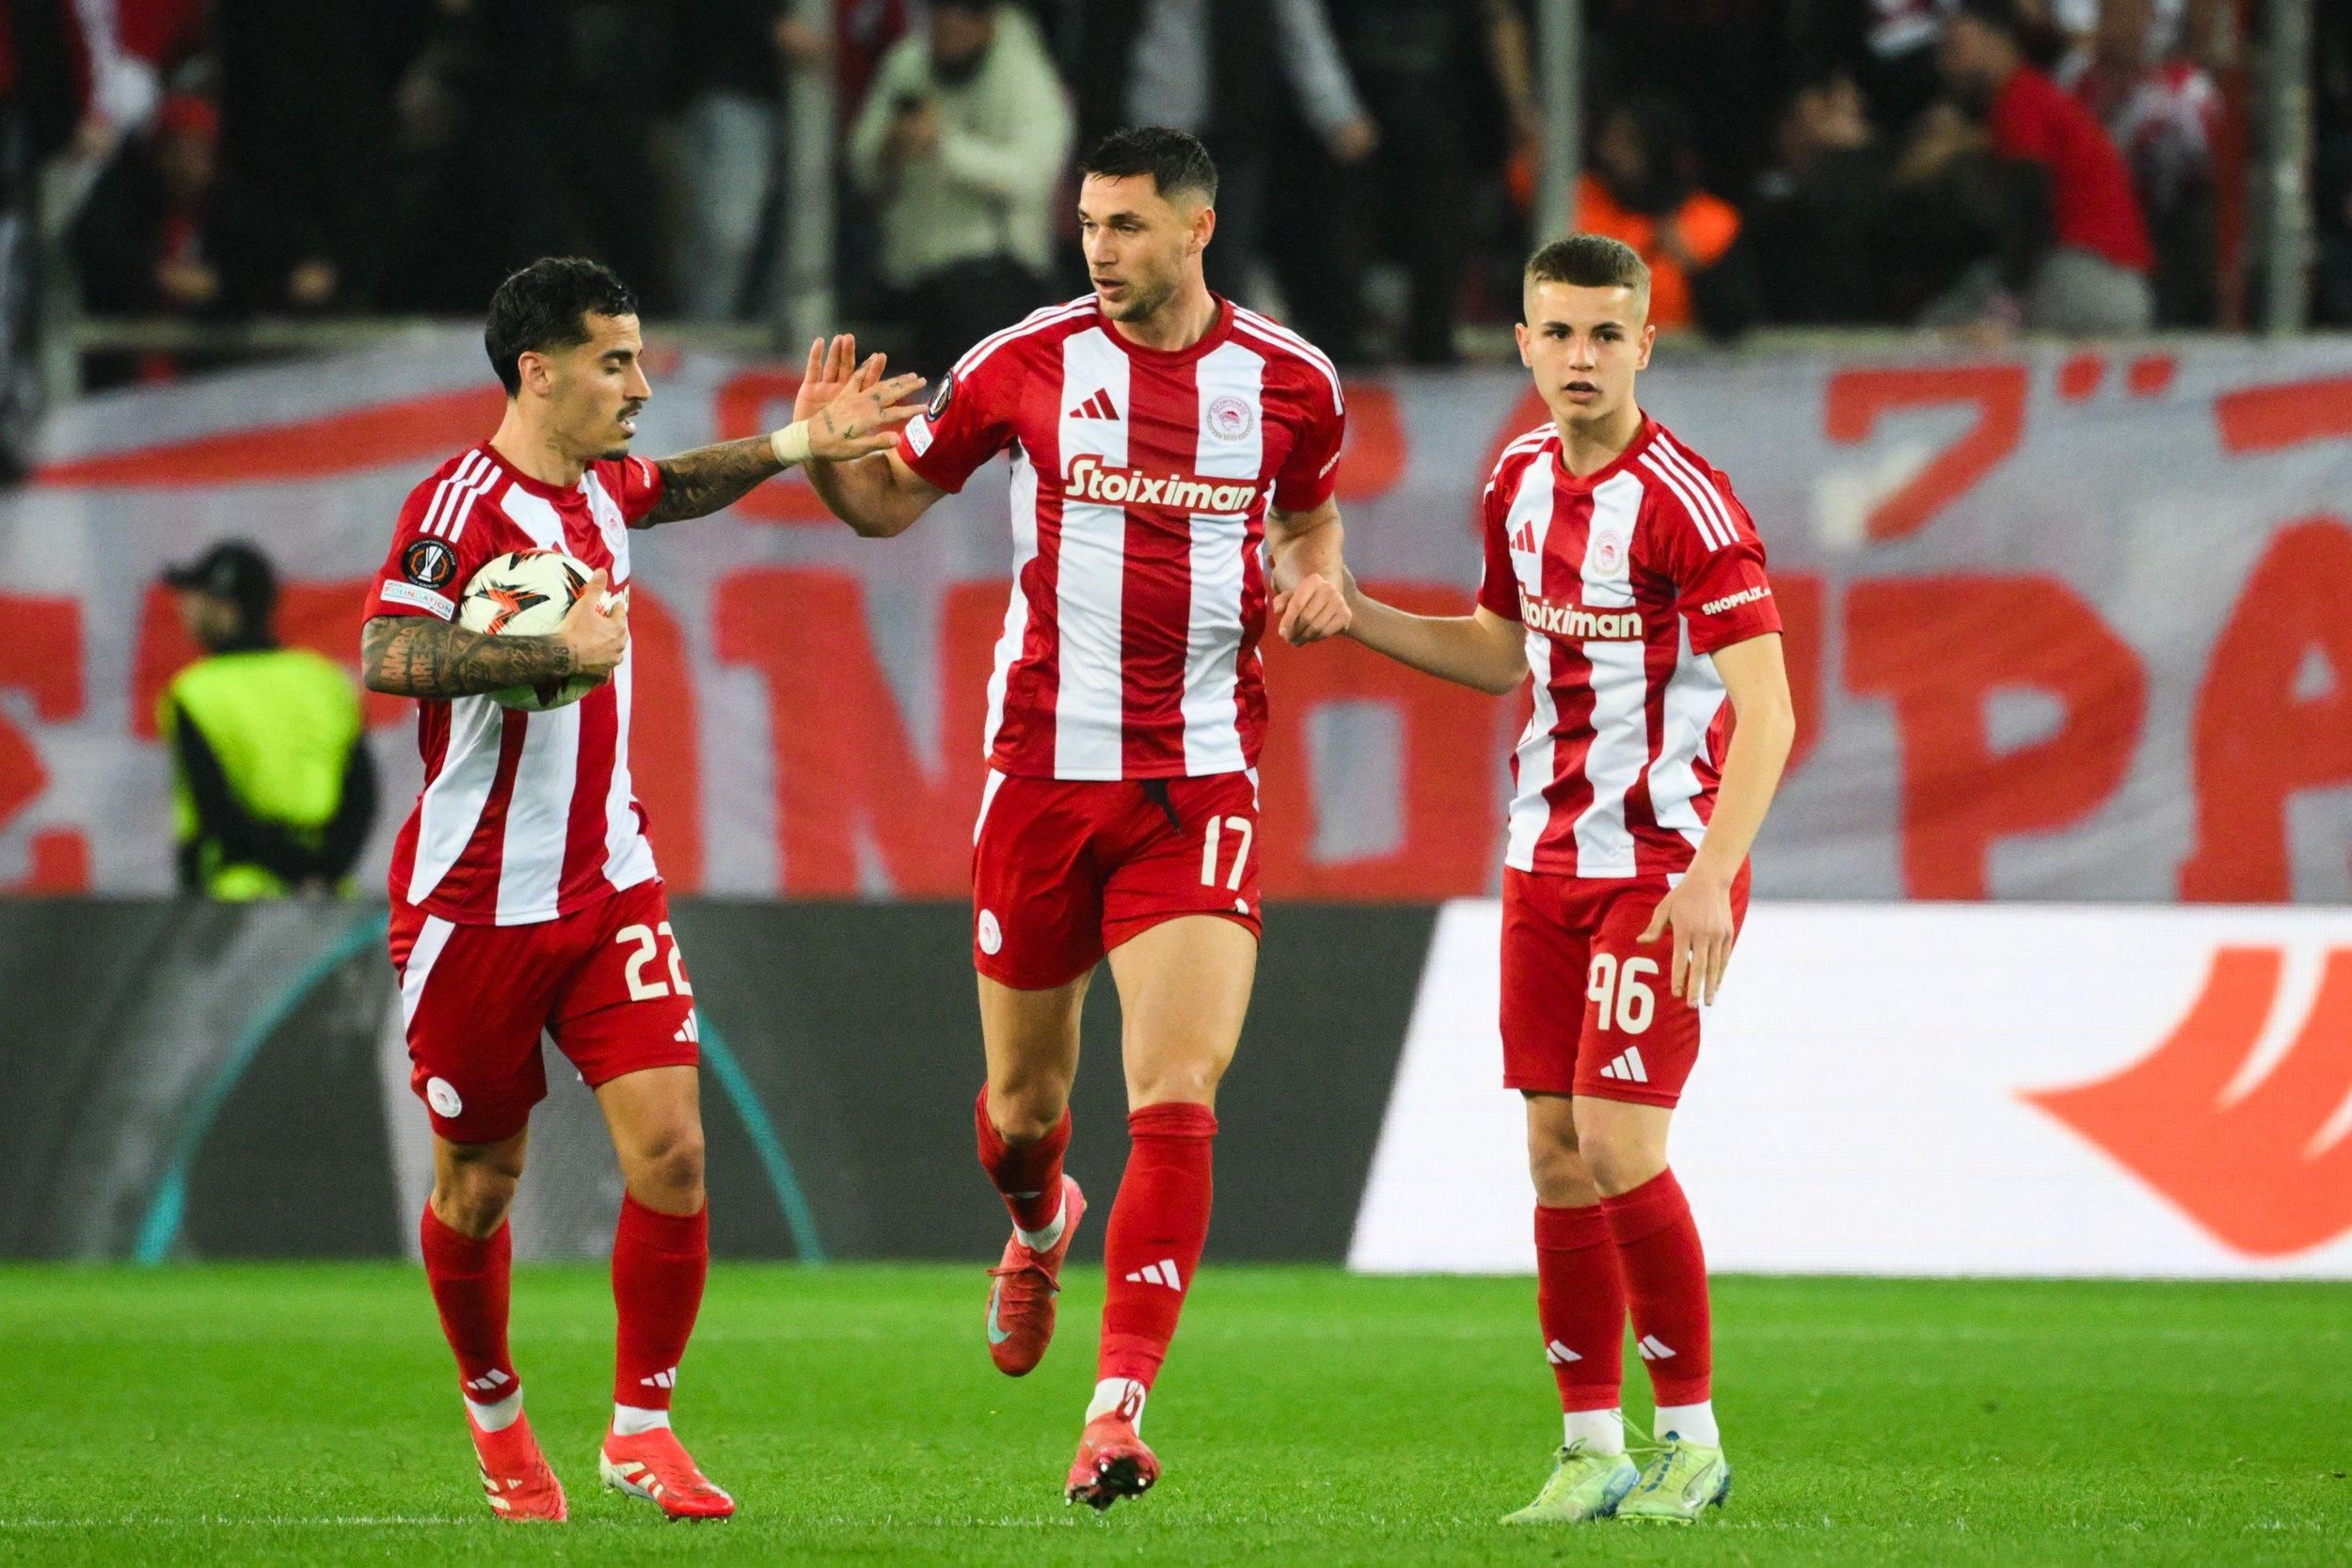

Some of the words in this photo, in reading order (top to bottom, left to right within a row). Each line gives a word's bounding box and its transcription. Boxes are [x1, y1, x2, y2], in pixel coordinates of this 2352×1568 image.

[1065, 459, 1256, 511] Stoiximan
[384, 586, 453, 614] FOUNDATION
[1200, 815, 1252, 891] 17
[616, 921, 693, 1002] 22
[1587, 952, 1659, 1035] 96
